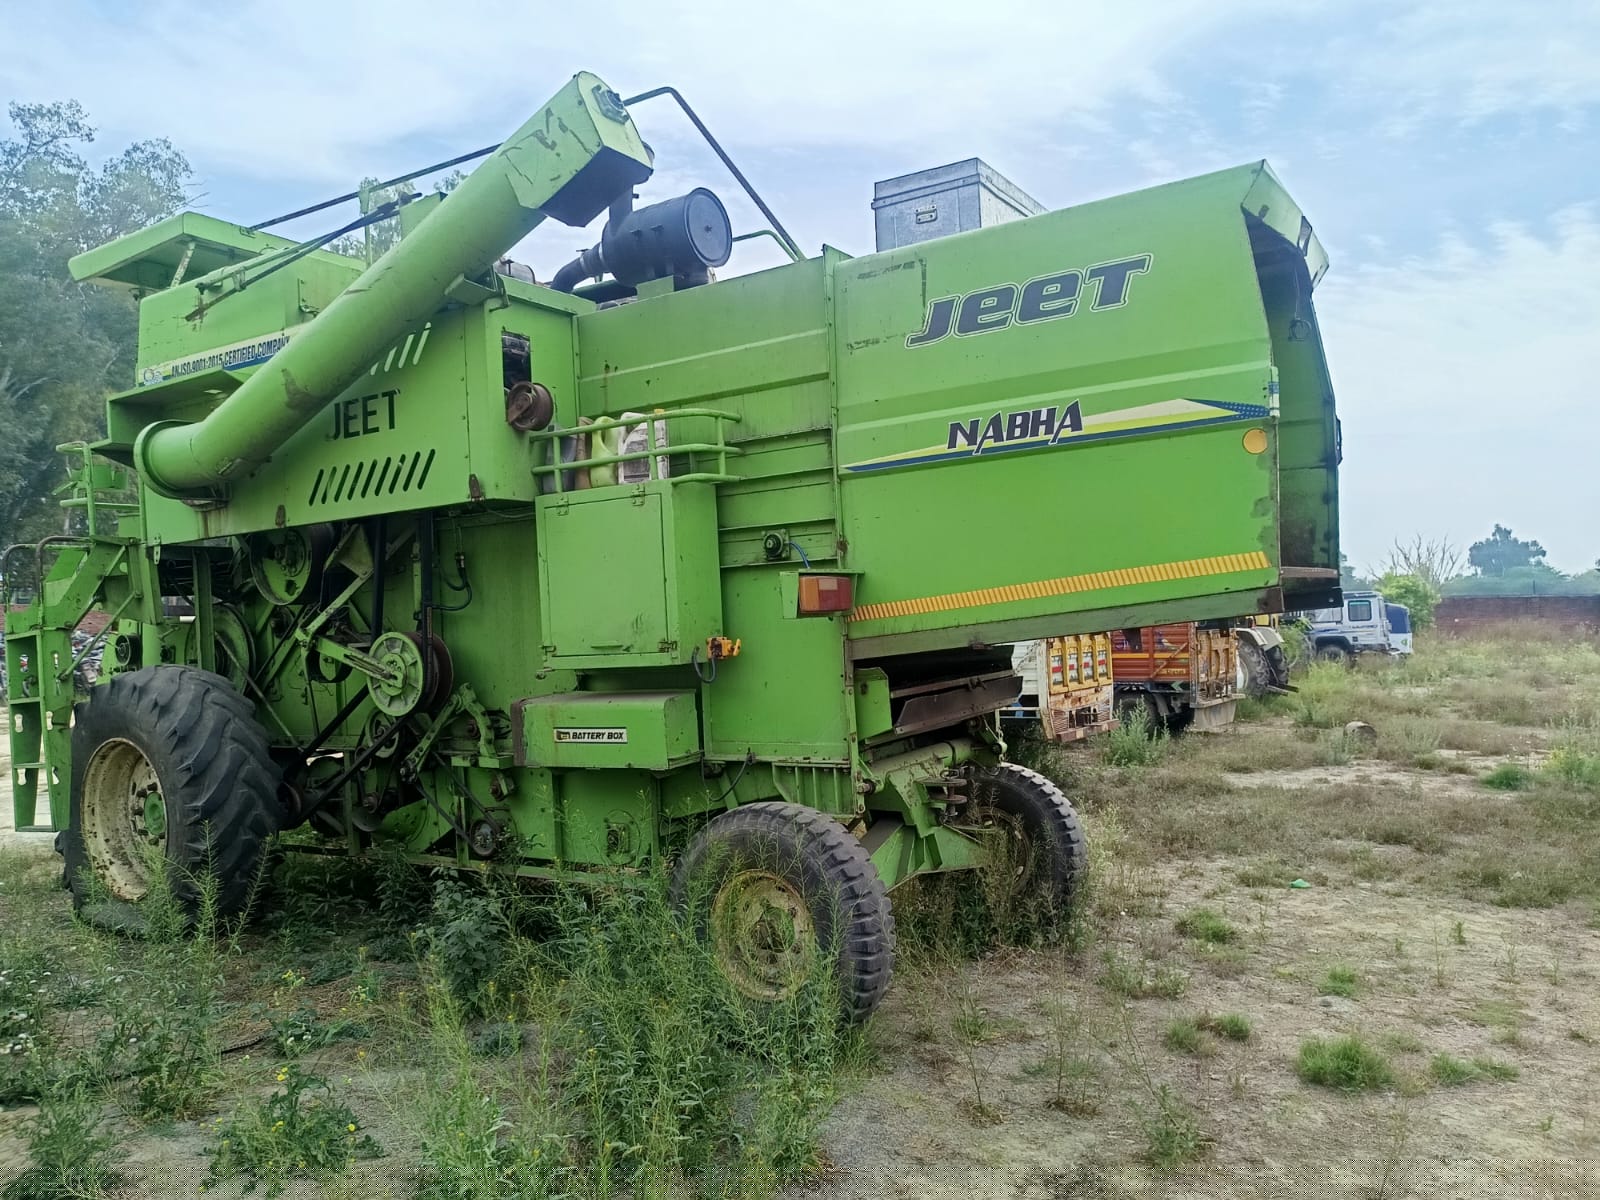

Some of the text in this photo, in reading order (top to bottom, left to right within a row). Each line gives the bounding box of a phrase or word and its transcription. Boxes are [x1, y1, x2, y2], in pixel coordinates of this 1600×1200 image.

[224, 344, 256, 367] CERTIFIED
[325, 388, 400, 441] JEET
[947, 399, 1083, 456] NABHA
[572, 731, 624, 740] BATTERY BOX
